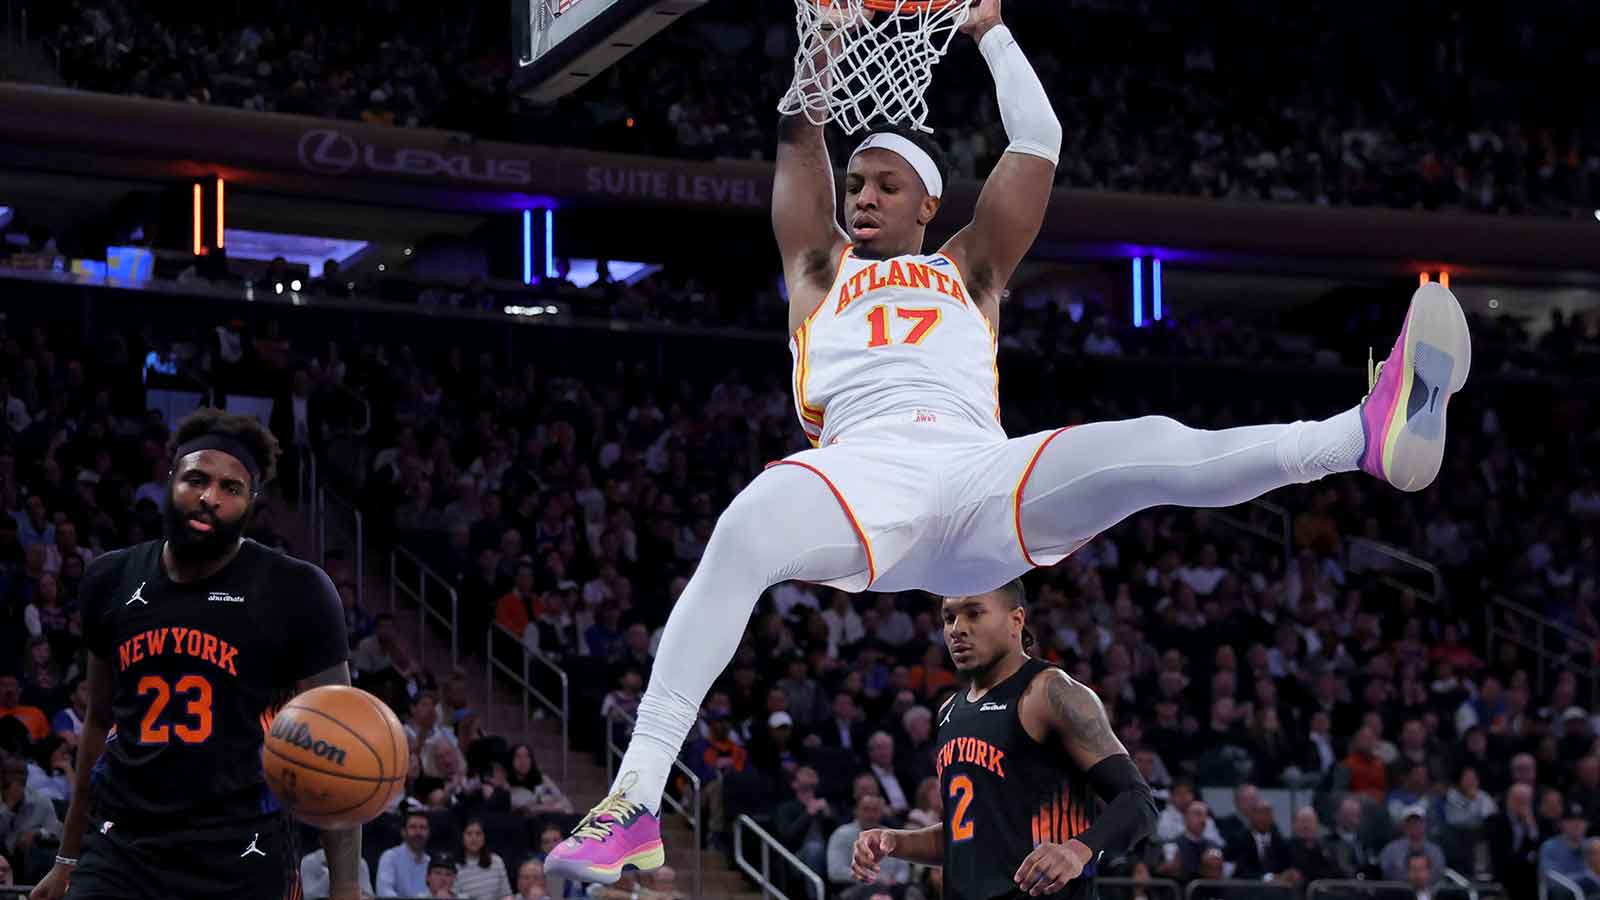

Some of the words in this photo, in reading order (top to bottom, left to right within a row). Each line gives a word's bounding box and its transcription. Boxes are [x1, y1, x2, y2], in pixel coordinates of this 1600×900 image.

[364, 144, 531, 184] LEXUS
[585, 167, 669, 199] SUITE
[676, 175, 762, 206] LEVEL
[834, 259, 969, 316] ATLANTA
[866, 304, 941, 348] 17
[118, 627, 169, 671] NEW
[171, 627, 239, 676] YORK
[136, 674, 213, 743] 23
[957, 736, 1005, 778] YORK
[949, 774, 974, 842] 2
